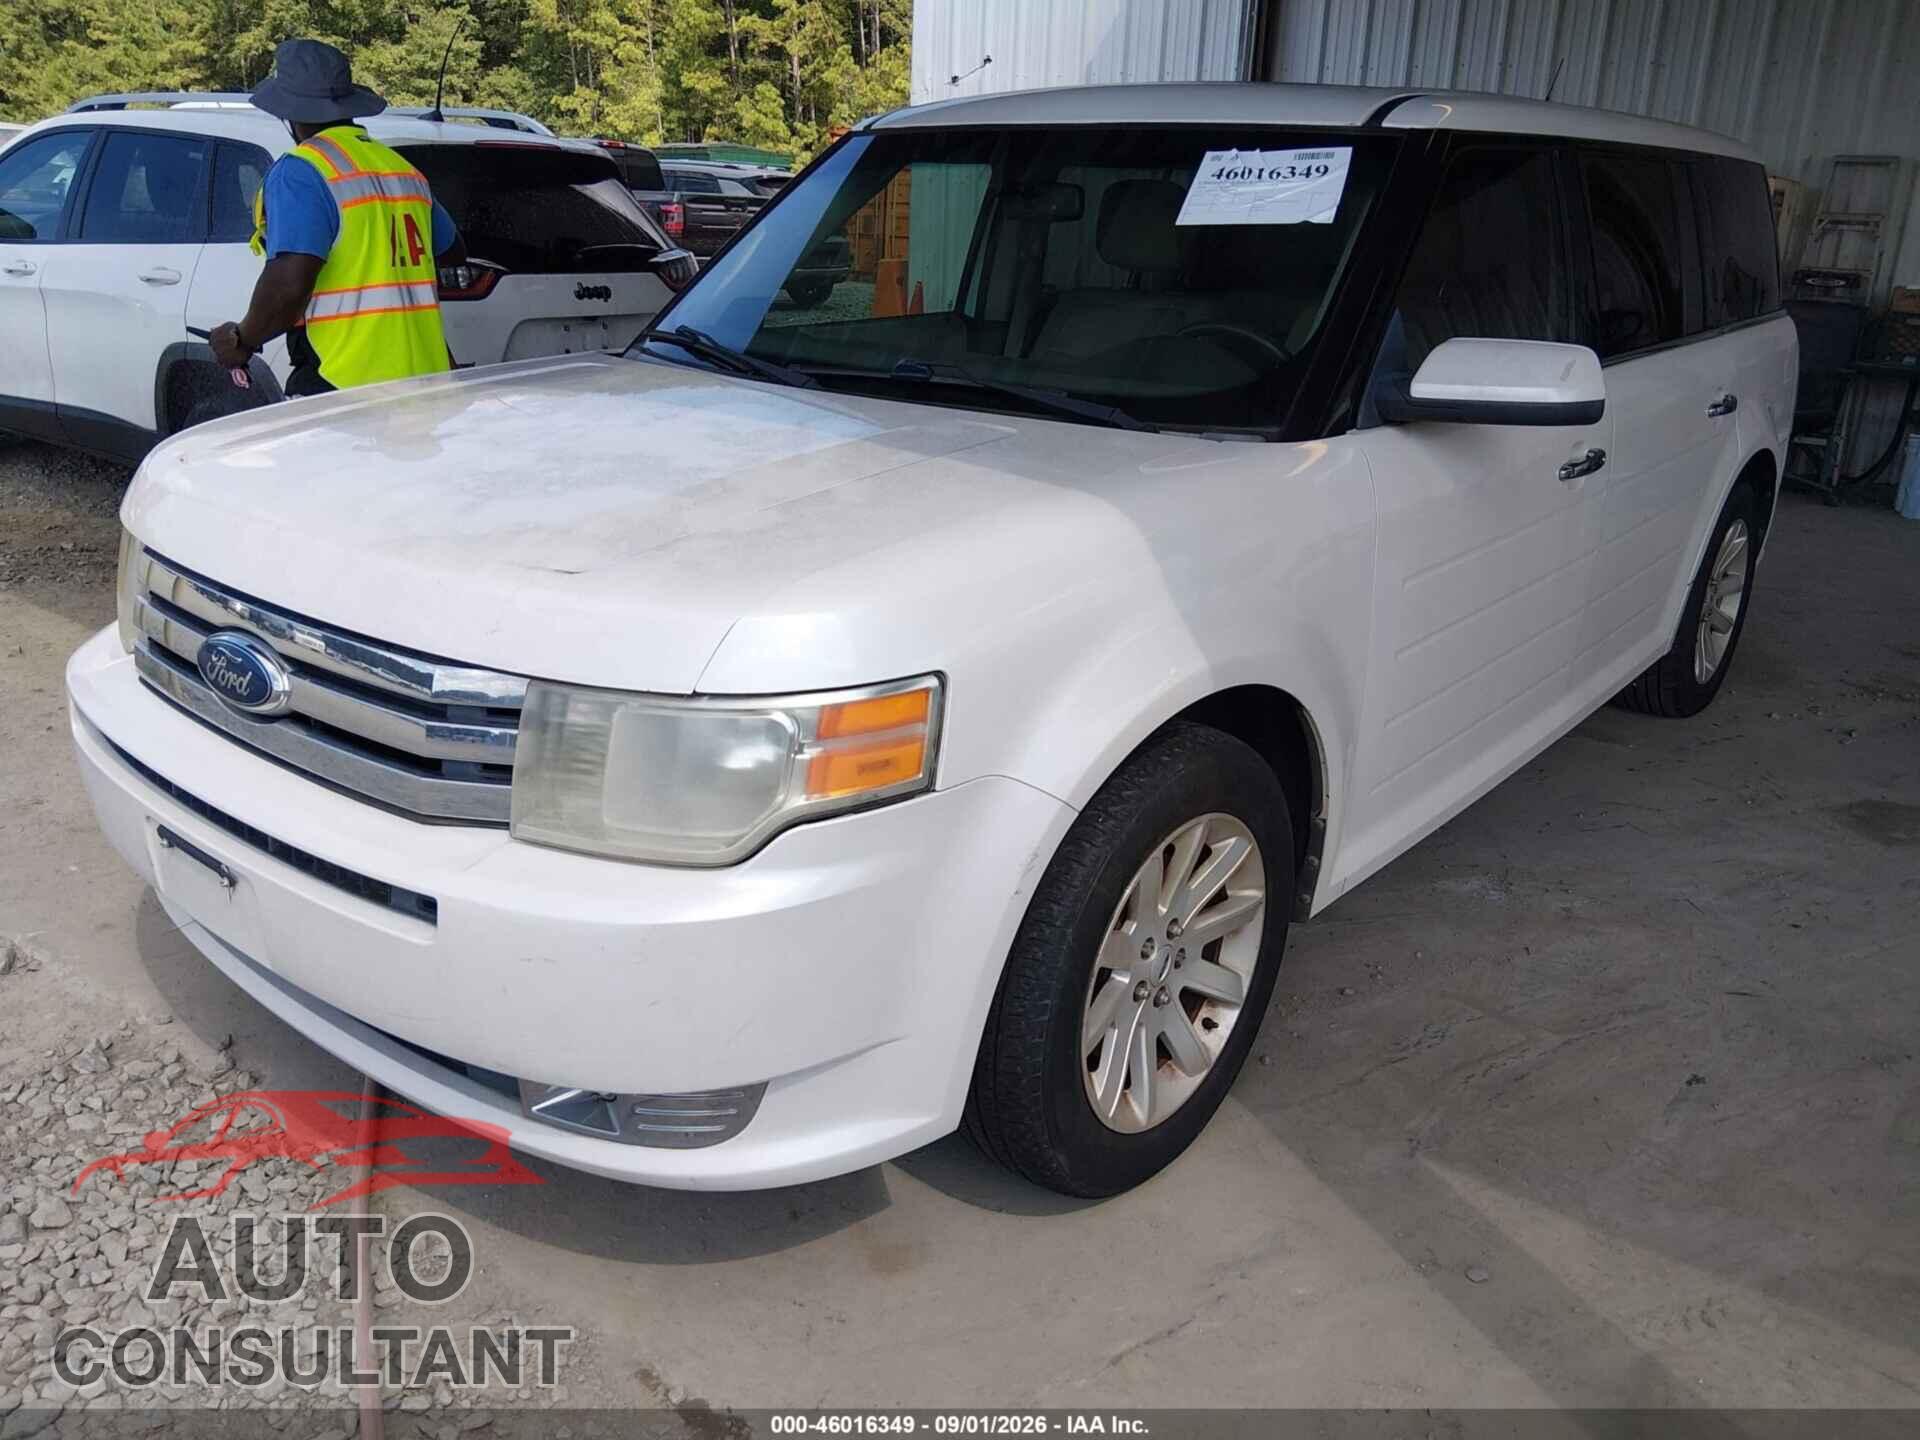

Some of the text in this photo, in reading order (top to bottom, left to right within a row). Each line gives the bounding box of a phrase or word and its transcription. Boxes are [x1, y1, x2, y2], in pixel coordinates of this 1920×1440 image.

[1211, 164, 1329, 180] 46016349
[573, 281, 612, 303] Jeep
[206, 646, 252, 696] Ford
